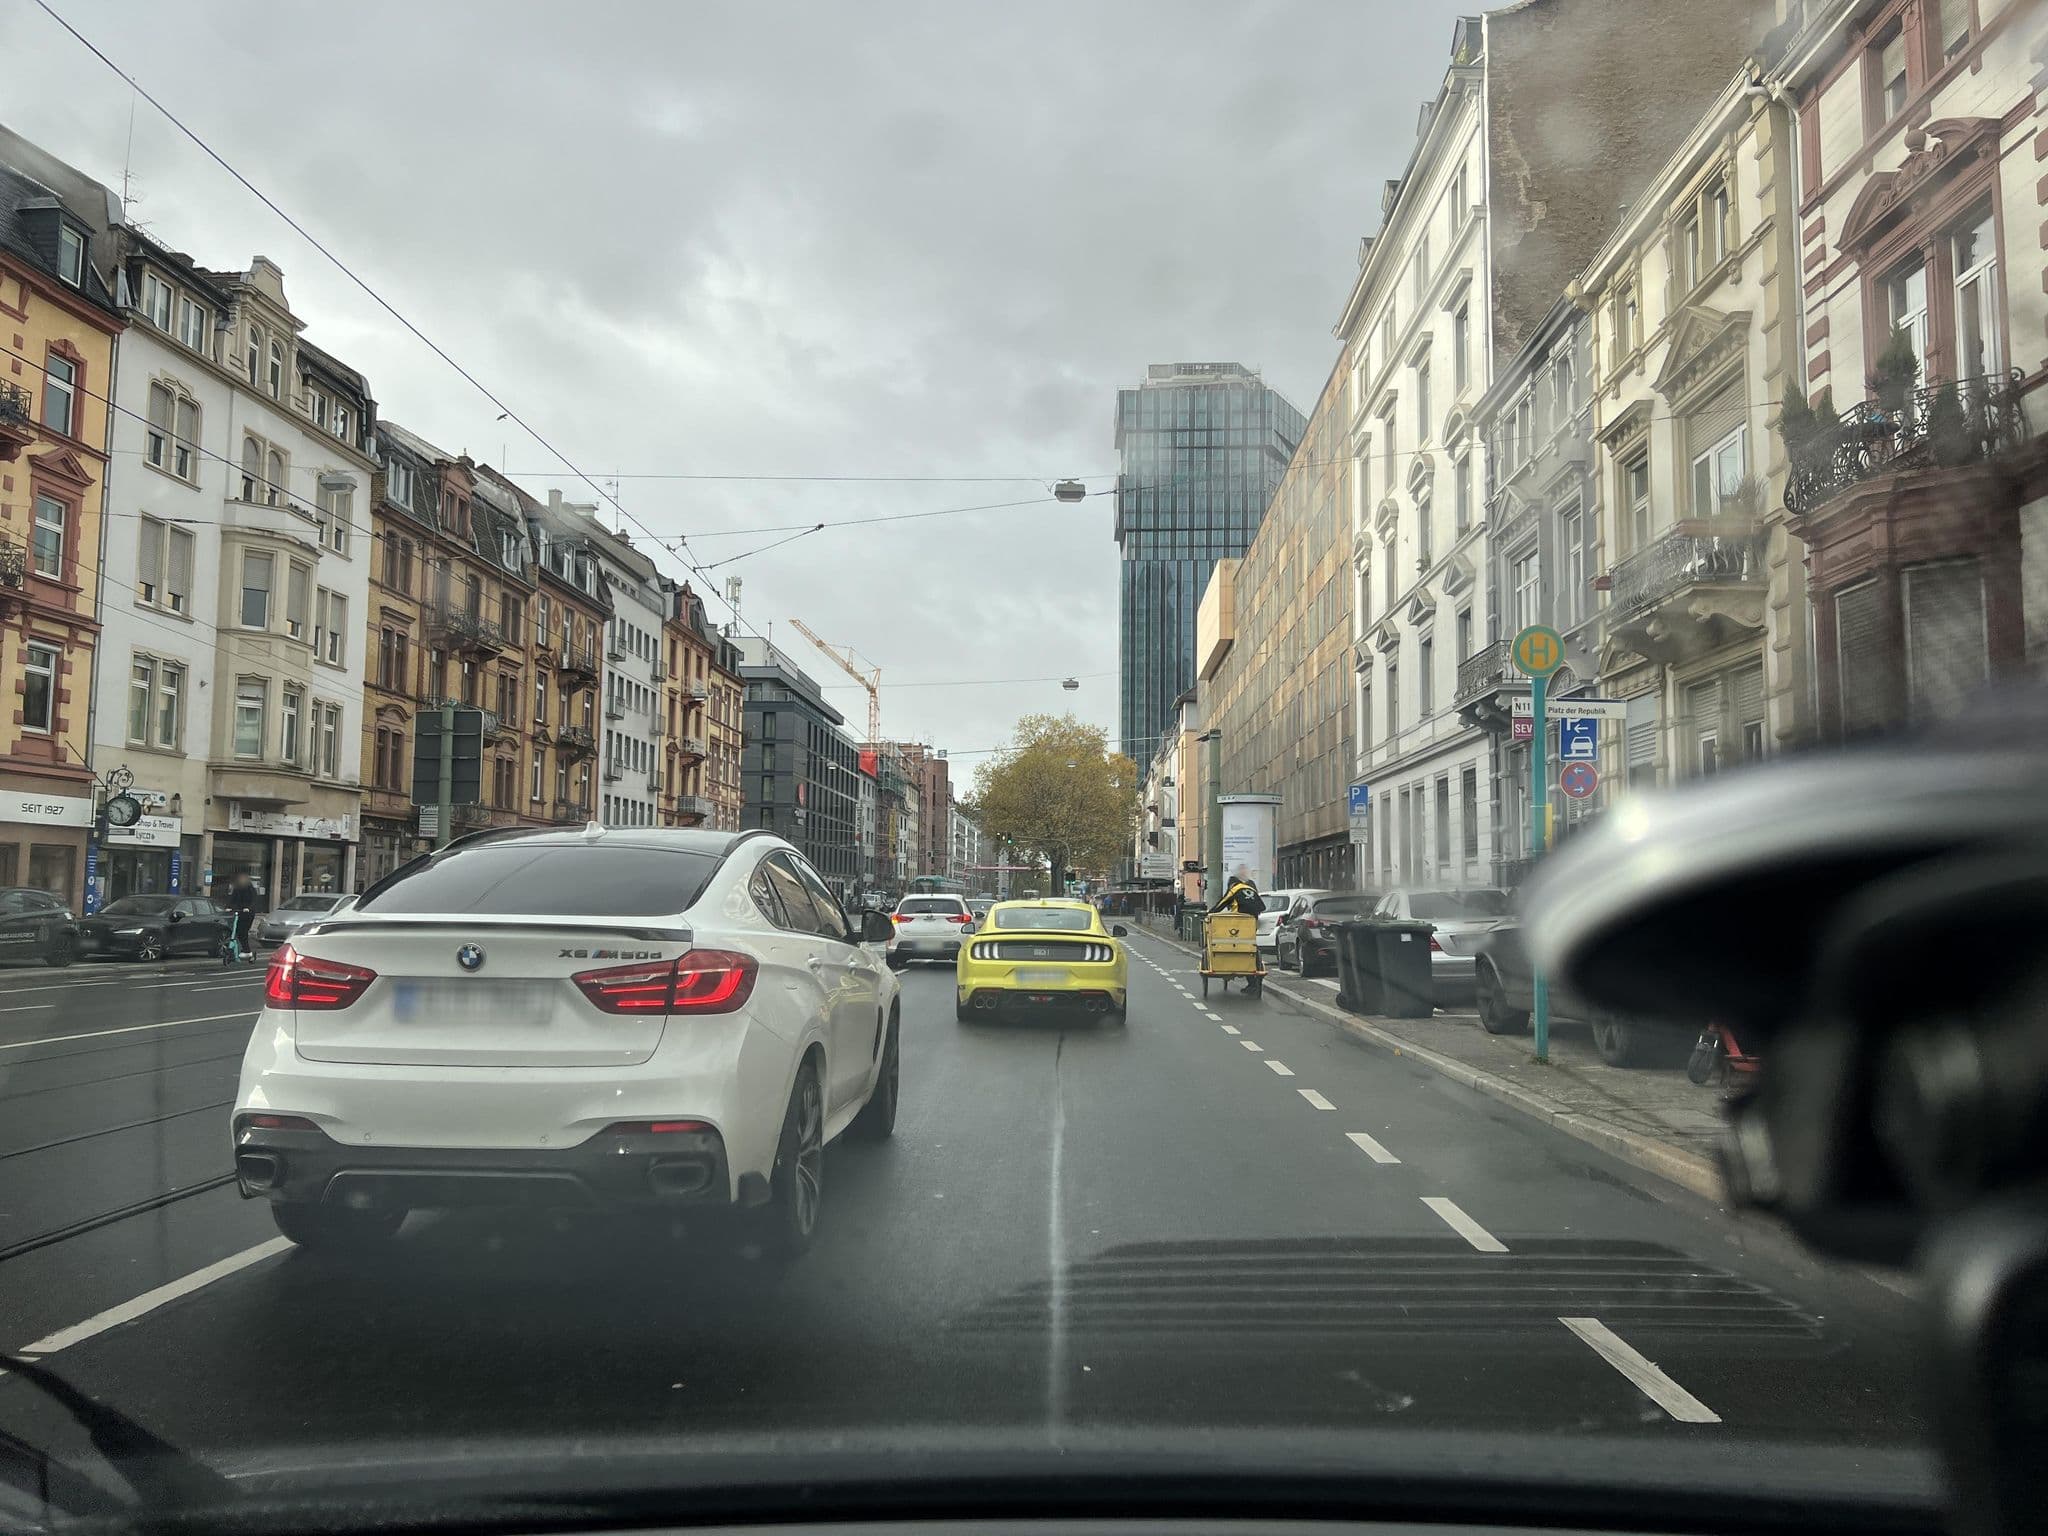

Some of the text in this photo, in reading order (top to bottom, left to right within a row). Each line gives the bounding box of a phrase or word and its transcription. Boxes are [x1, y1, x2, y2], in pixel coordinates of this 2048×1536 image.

[1529, 637, 1549, 665] H
[1515, 702, 1531, 711] N11
[1548, 706, 1606, 716] Platz der Republik
[1514, 723, 1533, 734] SEV
[1351, 787, 1360, 800] P
[21, 803, 64, 815] SEIT 1927
[152, 820, 158, 828] &
[158, 820, 174, 829] Travel
